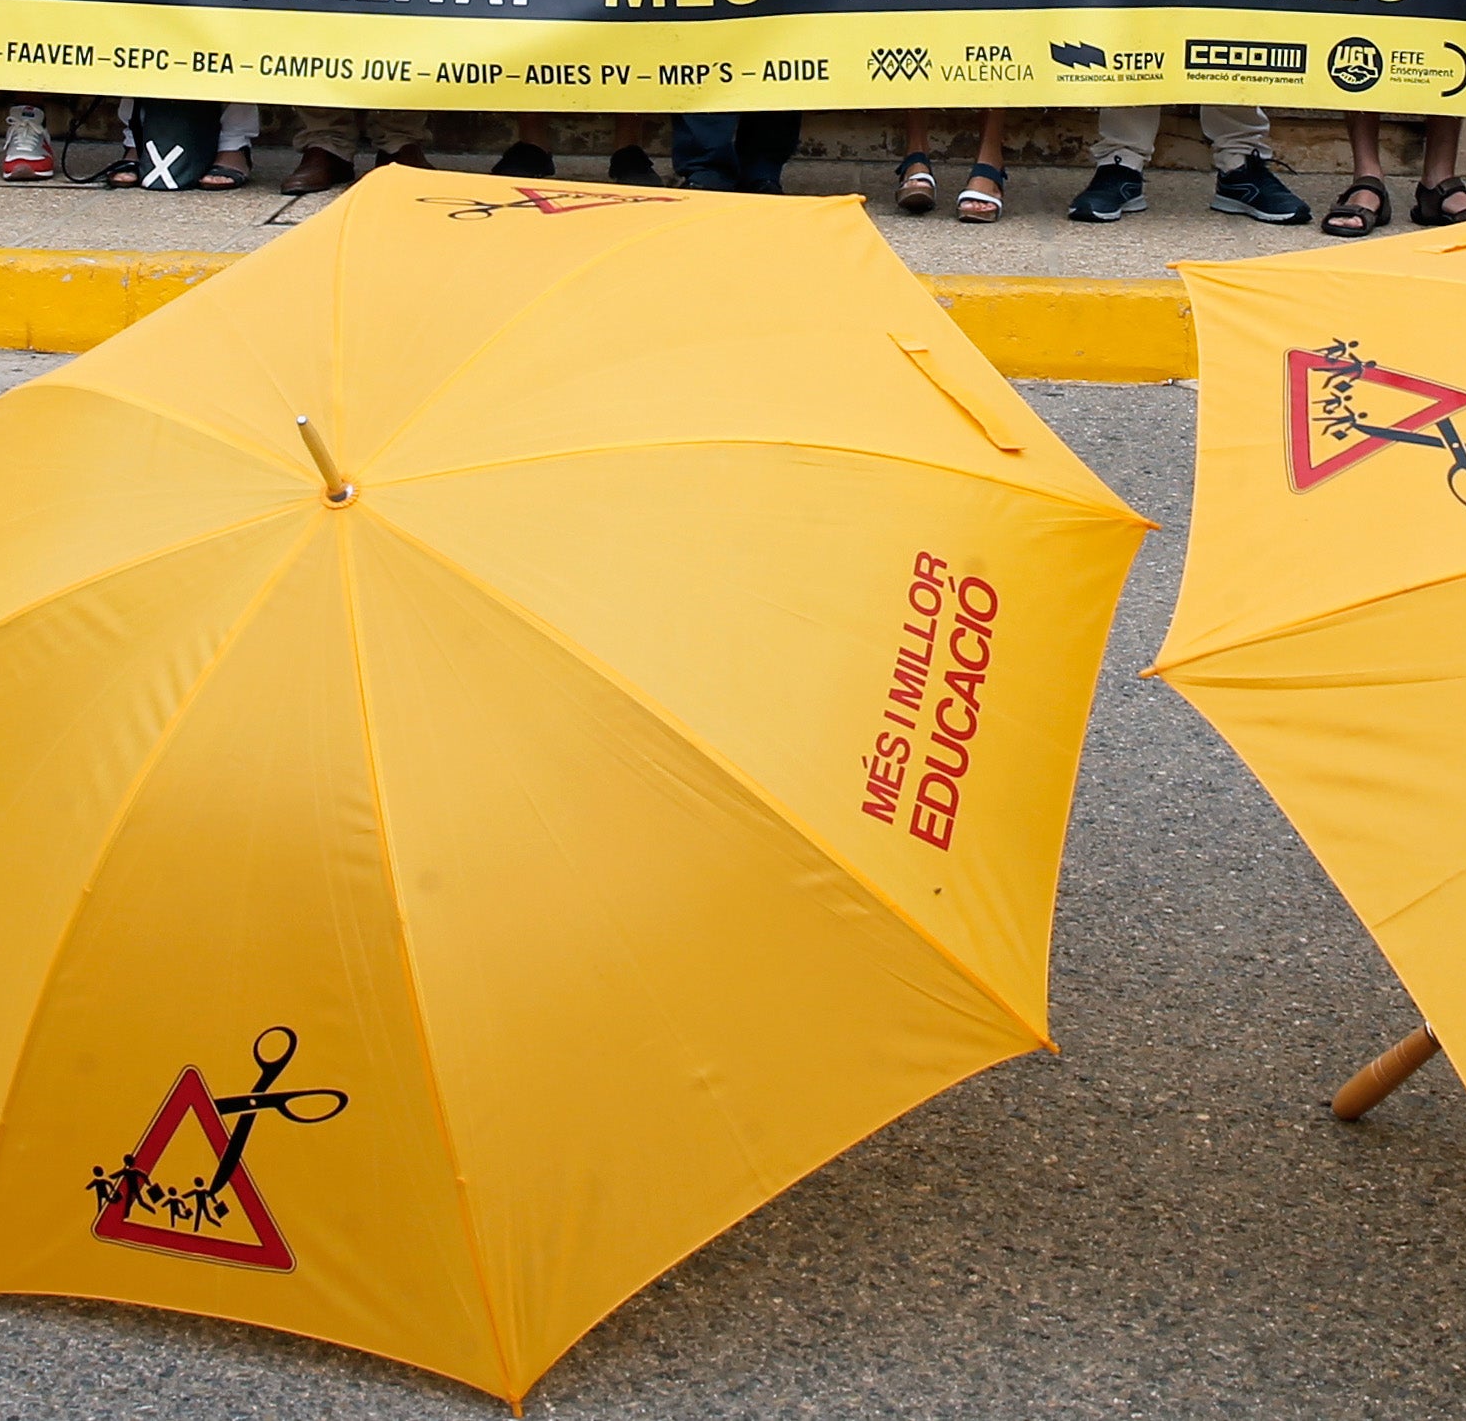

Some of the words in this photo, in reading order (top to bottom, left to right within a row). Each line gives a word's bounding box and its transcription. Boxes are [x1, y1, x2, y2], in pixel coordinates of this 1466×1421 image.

[7, 41, 94, 67] FAAVEM
[113, 46, 169, 71] SEPC
[192, 51, 235, 75] BEA
[259, 55, 354, 80] CAMPUS
[361, 58, 412, 83] JOVE
[436, 62, 503, 85] AVDIP
[525, 64, 592, 85] ADIES
[601, 64, 631, 85] PV
[762, 58, 829, 82] ADIDE
[965, 45, 1012, 63] FAPA
[1113, 52, 1165, 71] STEPV
[1190, 45, 1269, 67] CCOO
[1334, 45, 1377, 68] UGT
[1390, 51, 1425, 65] FETE
[941, 61, 1034, 82] VALÈNCIA
[1057, 74, 1115, 82] INTERSINDICAL
[1186, 72, 1229, 82] federació
[1232, 73, 1304, 85] d'ensenyament
[1390, 65, 1455, 78] Ensenyament
[888, 550, 947, 712] MILLOR
[884, 709, 916, 730] I
[908, 576, 999, 852] EDUCACIÓ
[861, 731, 911, 826] MÉS
